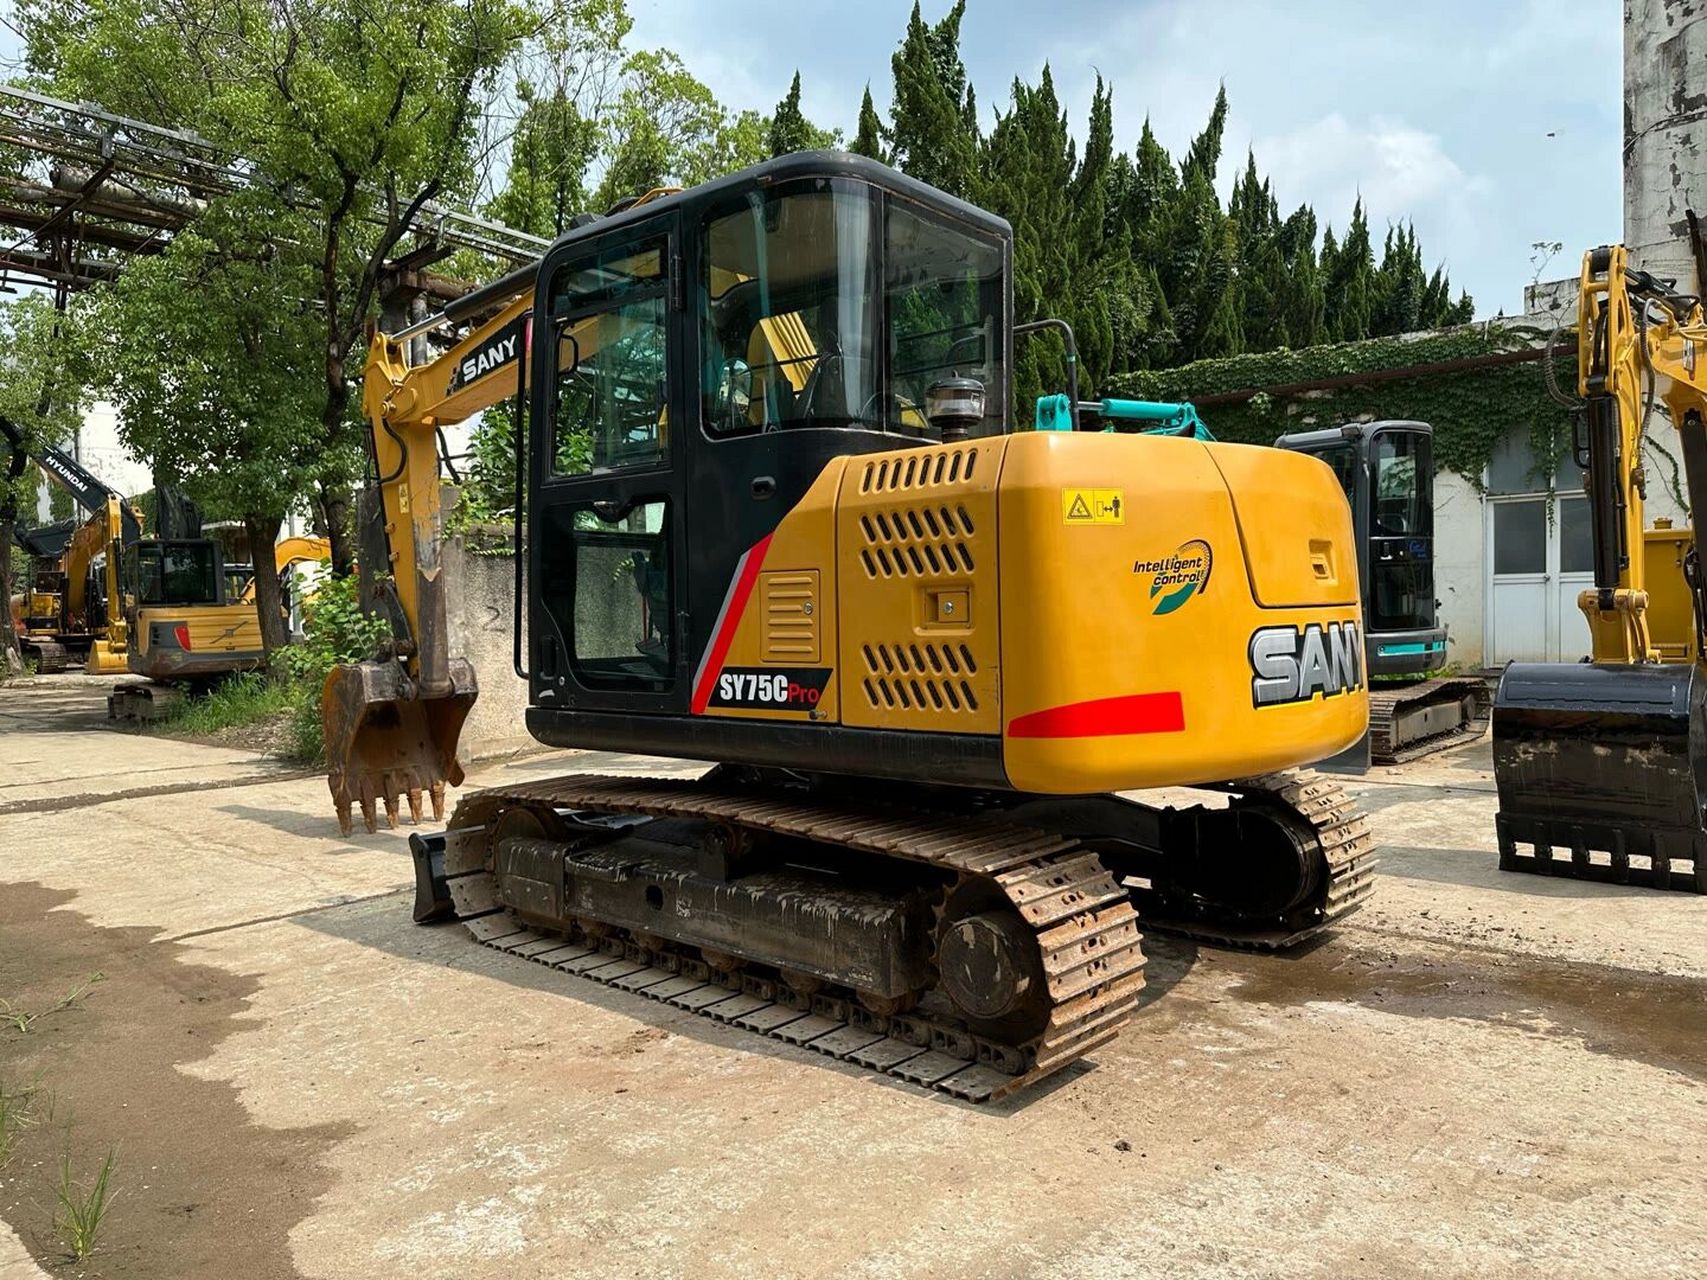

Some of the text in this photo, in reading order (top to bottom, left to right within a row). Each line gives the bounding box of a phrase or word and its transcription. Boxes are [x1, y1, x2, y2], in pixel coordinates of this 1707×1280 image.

[463, 334, 517, 382] SANY
[46, 456, 88, 492] HYUNDAI
[1133, 557, 1202, 574] Intelligent
[1153, 570, 1201, 585] control
